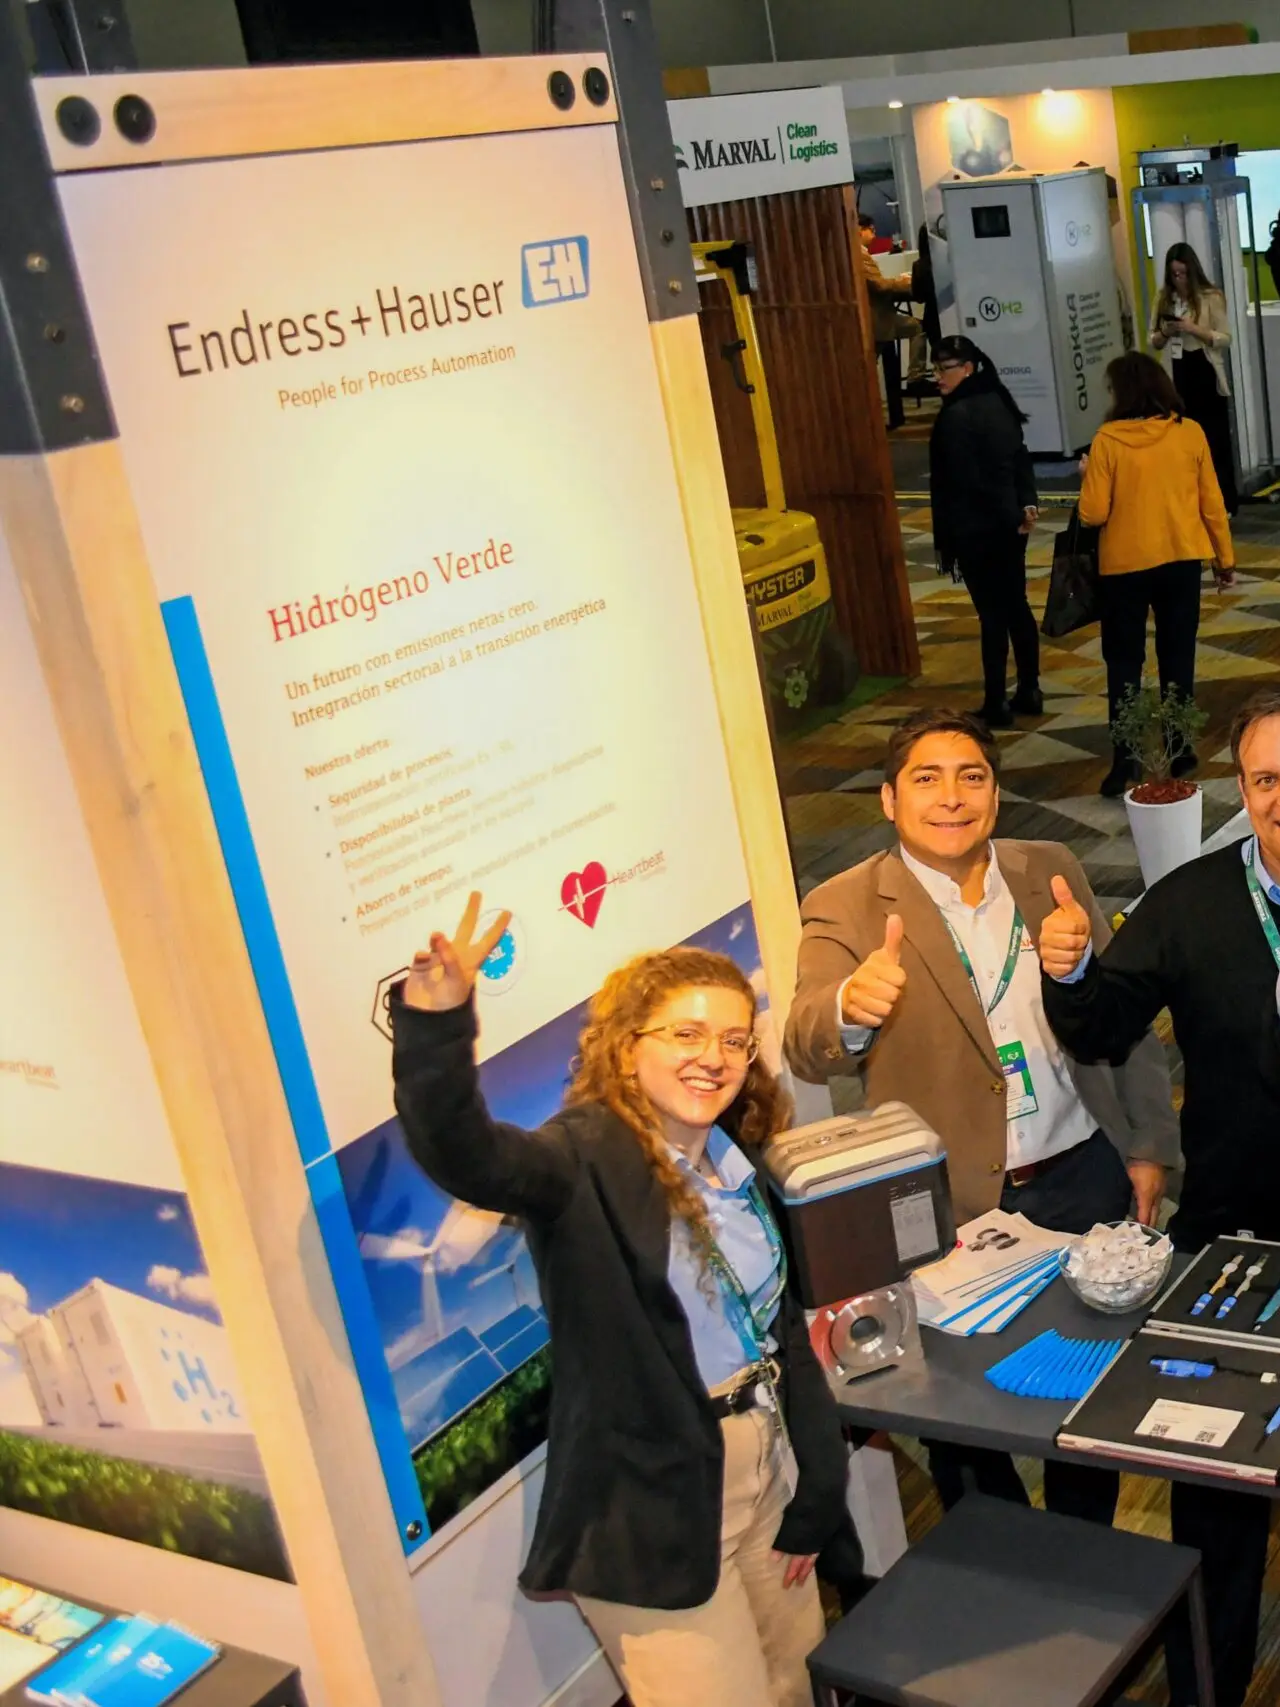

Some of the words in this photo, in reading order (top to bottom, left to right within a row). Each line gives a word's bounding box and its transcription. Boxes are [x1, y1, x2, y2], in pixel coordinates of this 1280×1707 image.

[691, 139, 776, 170] MARVAL
[787, 123, 817, 140] Clean
[790, 140, 838, 162] Logistics
[168, 279, 505, 378] Endress+Hauser
[1066, 293, 1088, 411] QUOKKA
[278, 381, 337, 410] People
[341, 375, 365, 395] for
[368, 362, 428, 389] Process
[431, 343, 516, 376] Automation
[268, 569, 430, 642] Hidrógeno
[433, 538, 515, 585] Verde
[285, 679, 311, 701] Un
[313, 663, 363, 692] futuro
[365, 653, 392, 672] con
[394, 626, 466, 661] emisiones
[469, 610, 506, 636] netas
[292, 685, 381, 728] Integración
[384, 659, 445, 693] sectorial
[448, 655, 458, 668] a
[460, 648, 474, 664] la
[476, 622, 541, 660] transición
[543, 597, 607, 633] energética
[304, 752, 353, 780] Nuestra
[329, 774, 387, 808] Seguridad
[389, 765, 403, 782] de
[339, 808, 420, 854] Disponibilidad
[422, 801, 436, 818] de
[356, 890, 397, 919] Ahorro
[399, 880, 412, 896] de
